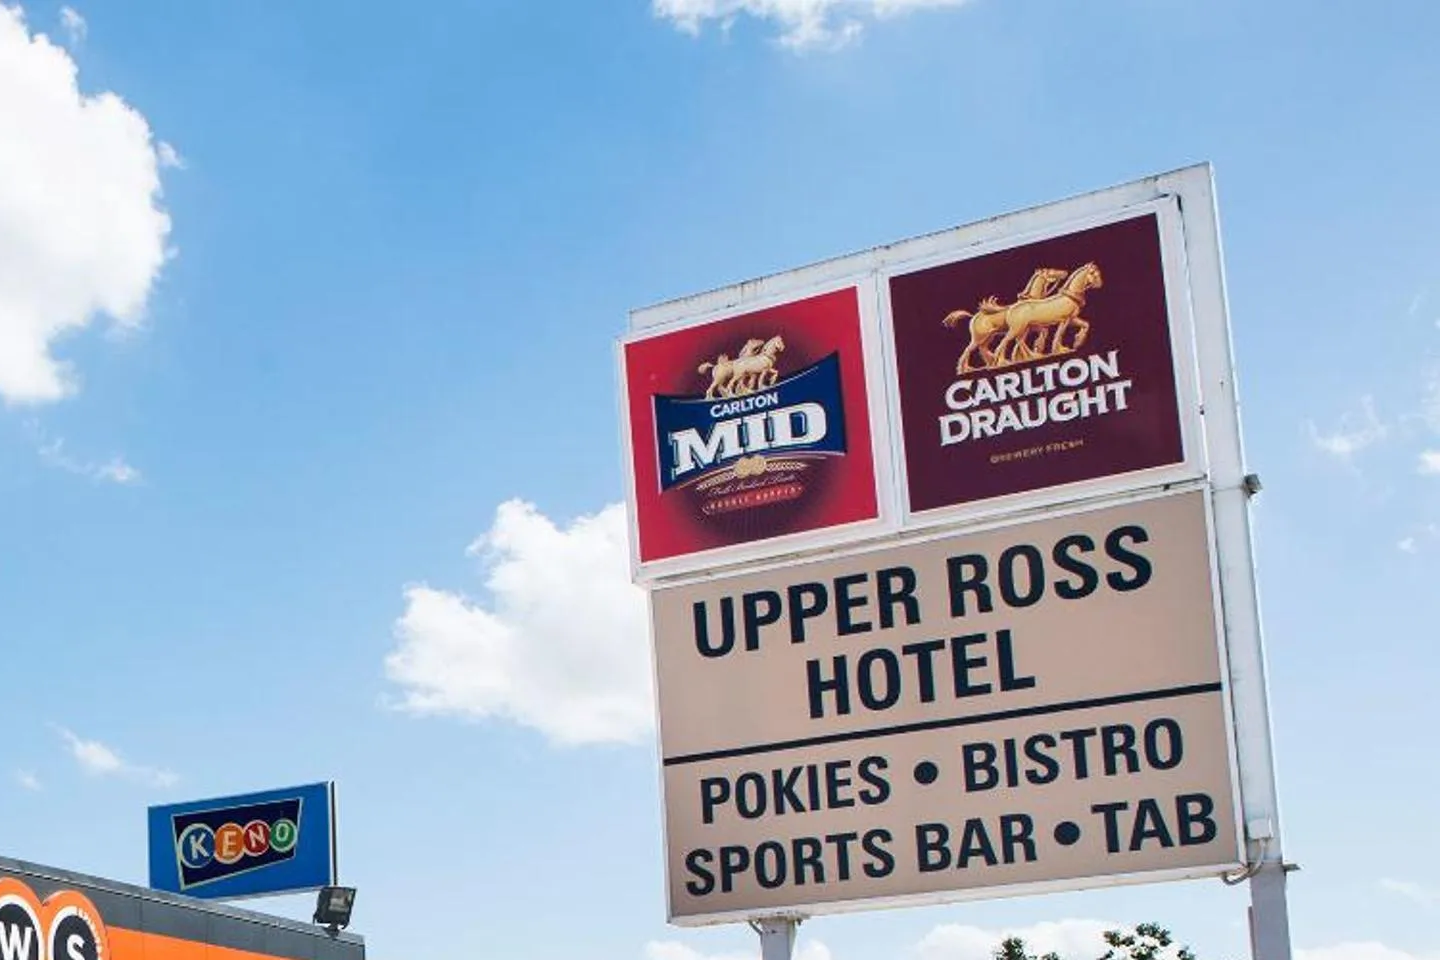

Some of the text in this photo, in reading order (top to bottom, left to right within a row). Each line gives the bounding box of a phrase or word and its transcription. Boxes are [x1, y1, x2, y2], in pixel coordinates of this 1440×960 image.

[709, 390, 779, 420] CARLTON
[938, 380, 1132, 447] DRAUGHT
[943, 350, 1120, 412] CARLTON
[668, 402, 828, 478] MID
[693, 524, 1153, 658] UPPER ROSS
[806, 629, 1035, 719] HOTEL
[700, 717, 1184, 824] POKIES BISTRO
[189, 822, 290, 860] KENO
[685, 793, 1218, 896] SPORTS BAR TAB
